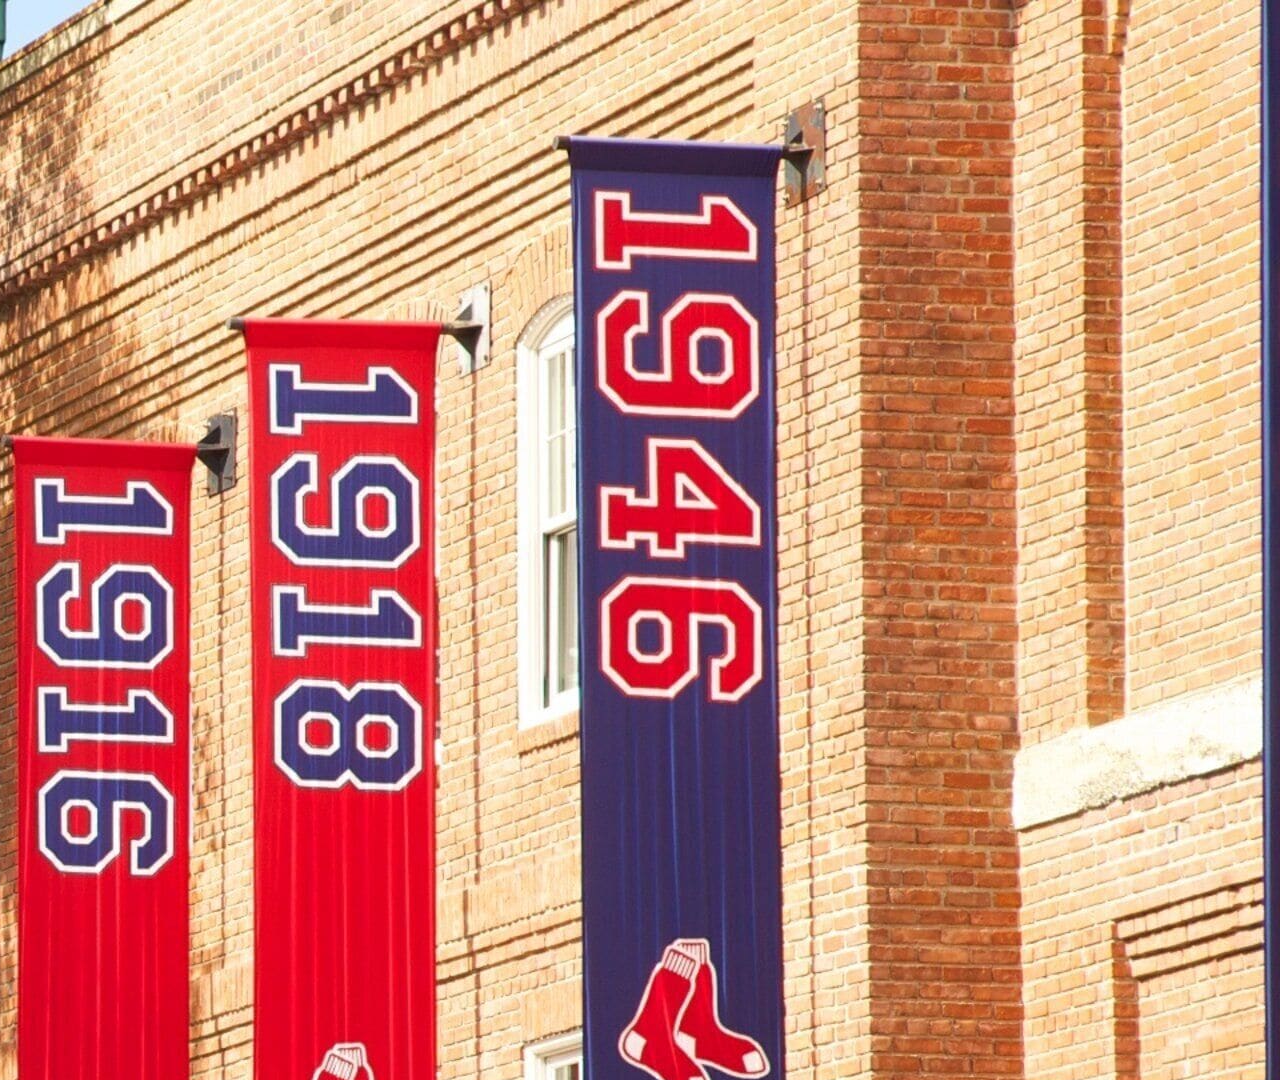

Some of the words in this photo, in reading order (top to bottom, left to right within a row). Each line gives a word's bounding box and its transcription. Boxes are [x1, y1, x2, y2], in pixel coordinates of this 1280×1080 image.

[268, 362, 423, 793] 1918
[593, 190, 765, 703] 1946
[33, 477, 175, 878] 1916
